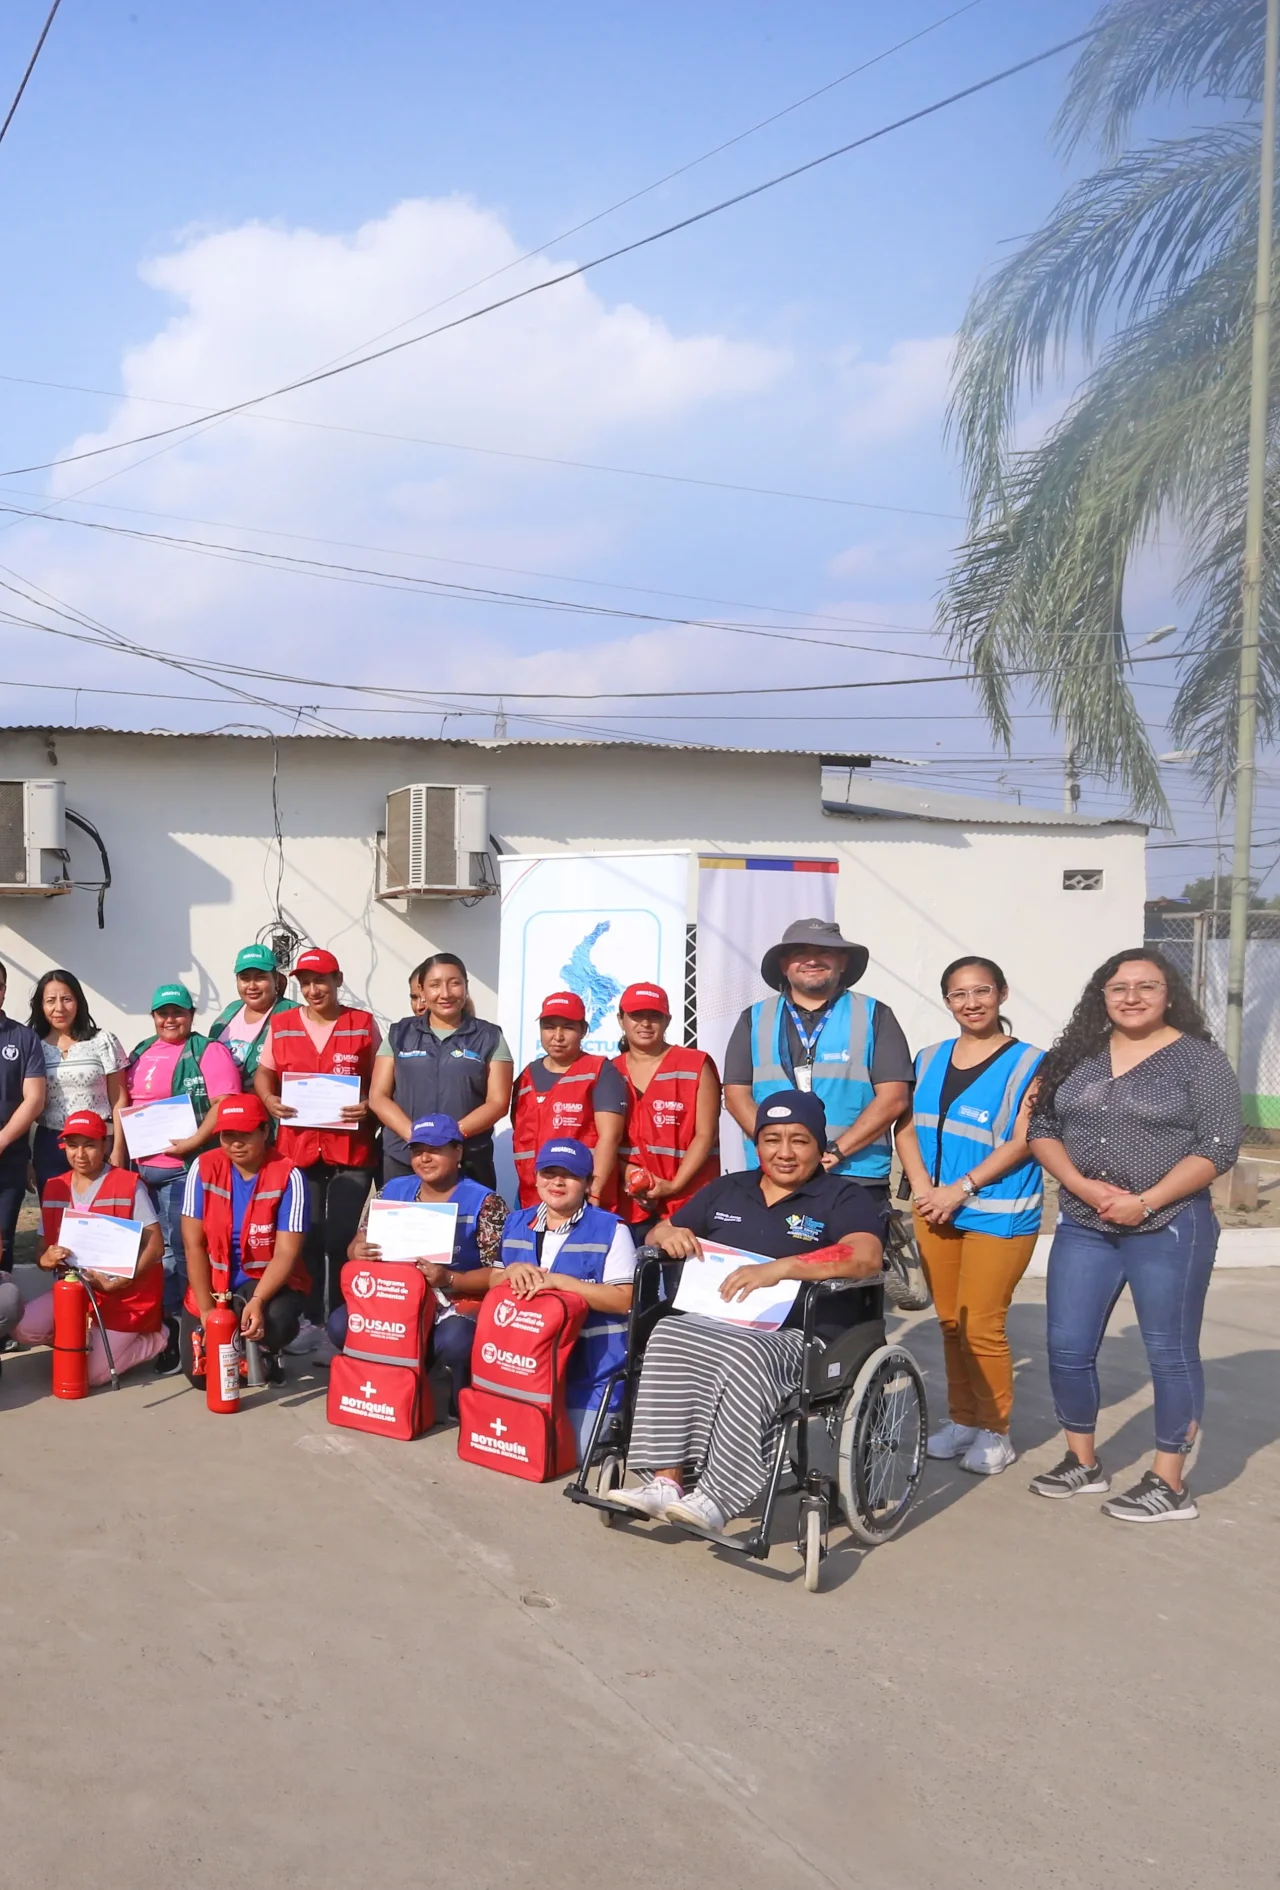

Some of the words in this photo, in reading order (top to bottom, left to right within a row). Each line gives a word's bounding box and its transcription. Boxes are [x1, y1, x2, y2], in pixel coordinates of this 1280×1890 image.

[377, 1278, 405, 1287] Programa
[377, 1285, 400, 1293] Mundial
[375, 1291, 406, 1300] Alimentos
[365, 1319, 406, 1334] USAID
[497, 1349, 537, 1369] USAID
[341, 1396, 395, 1416] BOTIQUÍN
[471, 1432, 527, 1456] BOTIQUÍN
